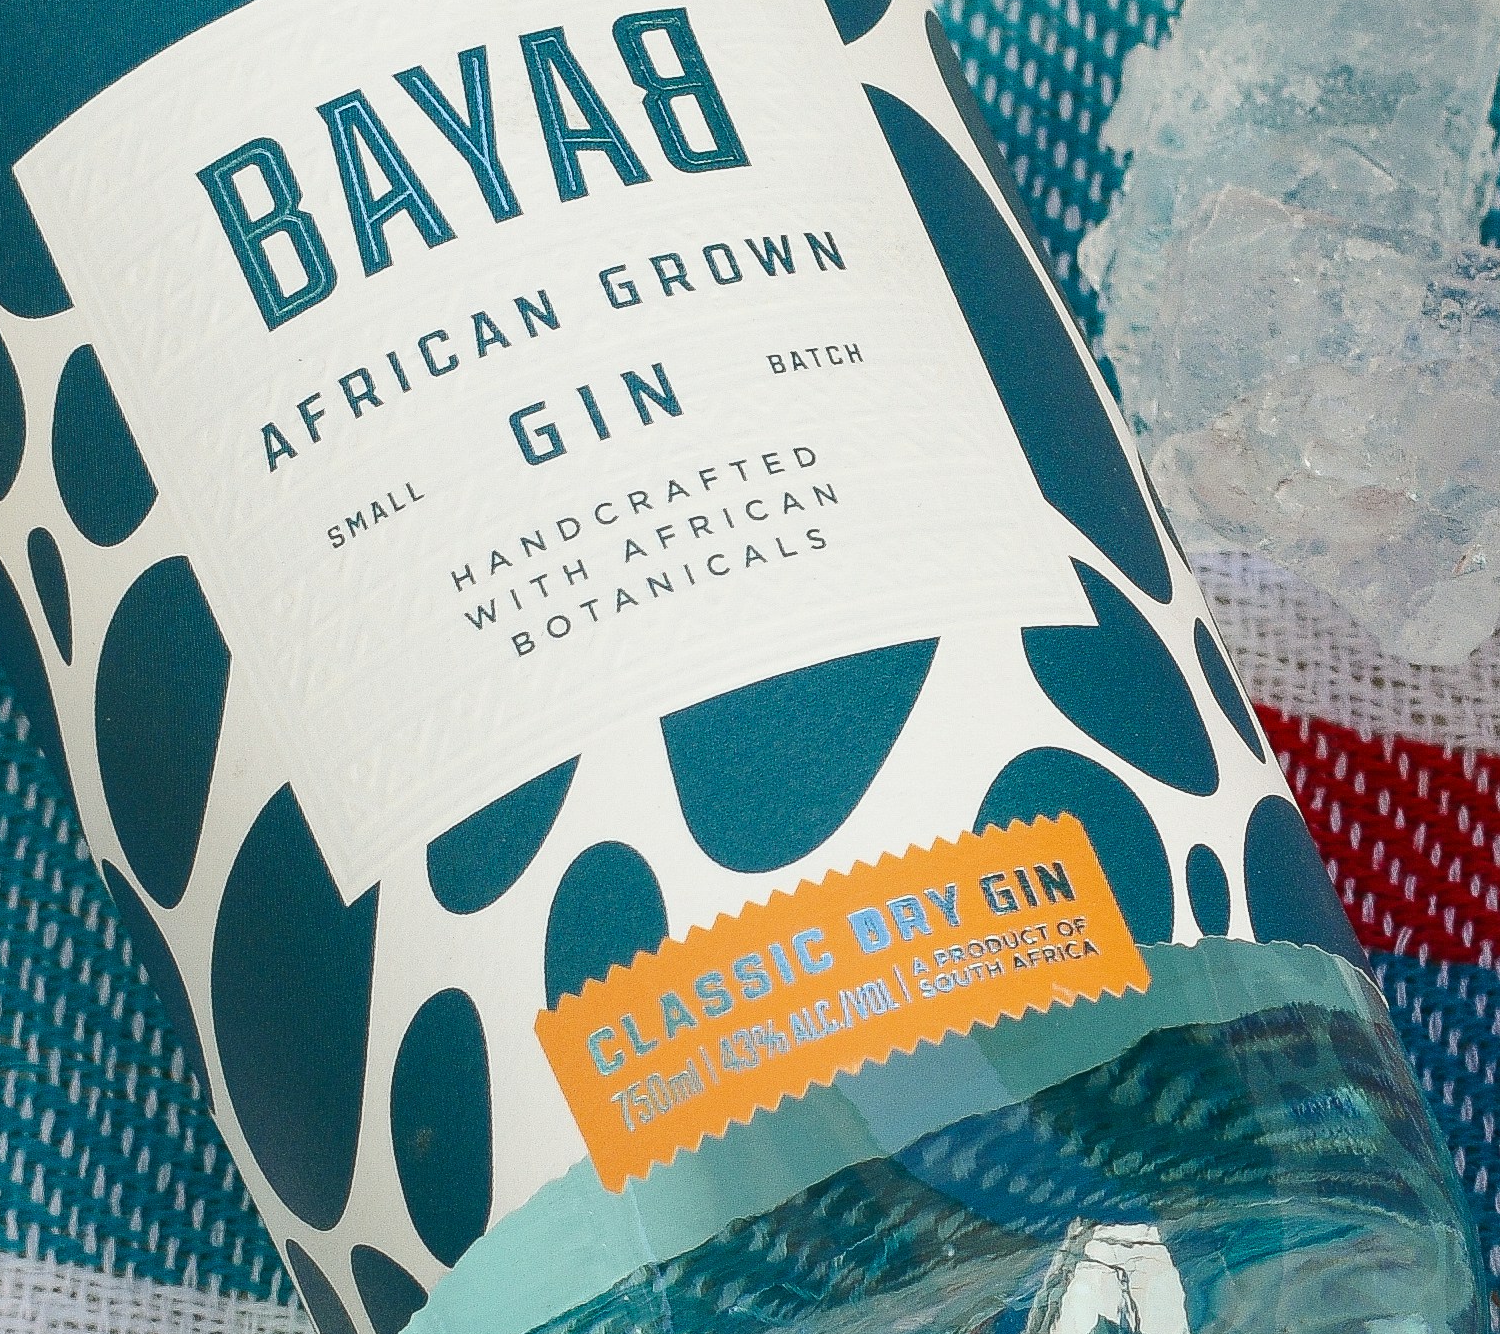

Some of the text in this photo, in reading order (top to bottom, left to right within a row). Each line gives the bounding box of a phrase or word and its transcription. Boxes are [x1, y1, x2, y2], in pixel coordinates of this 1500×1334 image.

[195, 7, 751, 332] BAYAB
[261, 232, 846, 472] AFRICAN GROWN
[509, 363, 683, 466] GIN
[328, 344, 863, 548] SMALL BATCH
[451, 447, 816, 591] HANDCRAFTED
[465, 484, 838, 629] WITH AFRICAN
[512, 529, 826, 656] BOTANICALS
[587, 860, 1075, 1075] CLASSIC DRY GIN
[913, 916, 1086, 976] A PRODUCT OF
[919, 938, 1100, 998] SOUTH AFRICA
